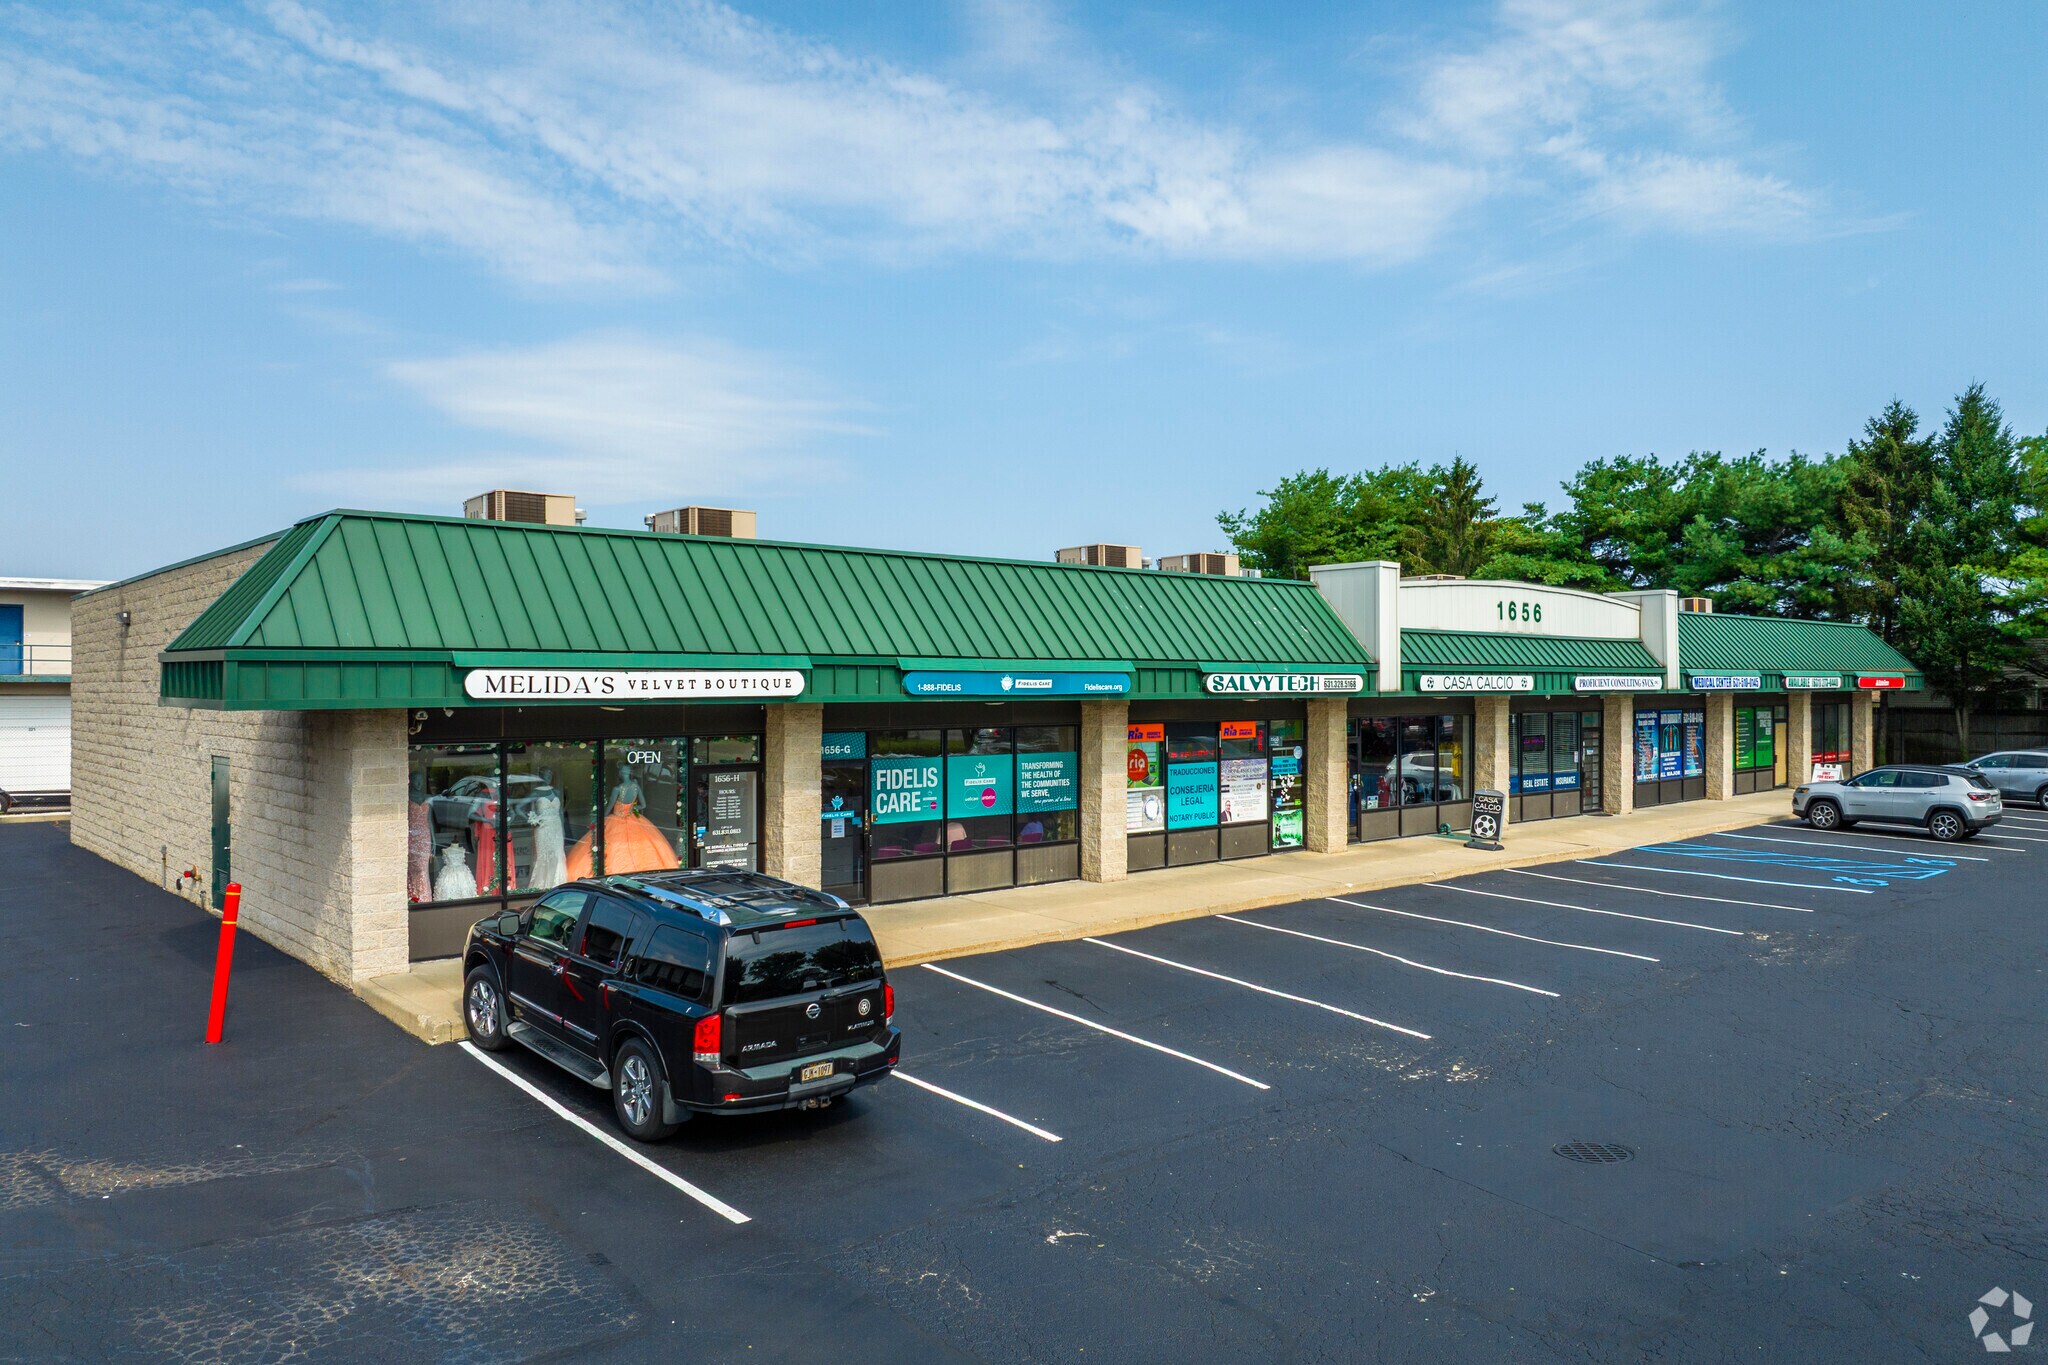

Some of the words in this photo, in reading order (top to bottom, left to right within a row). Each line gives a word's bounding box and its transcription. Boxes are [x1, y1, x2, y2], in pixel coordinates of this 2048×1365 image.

[1497, 601, 1542, 622] 1656
[485, 675, 615, 694] MELIDA'S
[628, 679, 697, 690] VELVET
[705, 678, 792, 690] BOUTIQUE
[917, 683, 962, 691] 1-888-FIDELIS
[1212, 675, 1320, 692] SALVYTECH
[1443, 676, 1473, 690] CASA
[1476, 676, 1514, 690] CALCIO
[1579, 678, 1610, 688] PROFICIENT
[1611, 678, 1641, 688] CONSULTING
[1694, 677, 1715, 688] MEDICAL
[1716, 677, 1732, 688] CENTER
[1128, 727, 1144, 739] Ria
[1223, 725, 1238, 736] Ria
[821, 745, 851, 754] 1656-G
[627, 751, 661, 764] OPEN
[1021, 761, 1064, 770] TRANSFORMING
[1033, 770, 1053, 778] HEALTH
[1169, 766, 1215, 776] TRADUCCIONES
[714, 774, 740, 783] 1656-H
[876, 767, 938, 790] FIDELIS
[1032, 779, 1071, 788] COMMUNITIES
[1522, 779, 1534, 788] REAL
[1534, 778, 1549, 787] ESTATE
[1555, 776, 1576, 785] INSURANCE
[1021, 790, 1030, 798] WE
[1169, 784, 1215, 795] CONSEJERIA
[876, 791, 922, 814] CARE
[1180, 796, 1205, 806] LEGAL
[1478, 796, 1499, 804] CASA
[1474, 802, 1502, 811] CALCIO
[1169, 813, 1193, 823] NOTARY
[1194, 811, 1215, 820] PUBLIC
[741, 1040, 778, 1053] ARMADA
